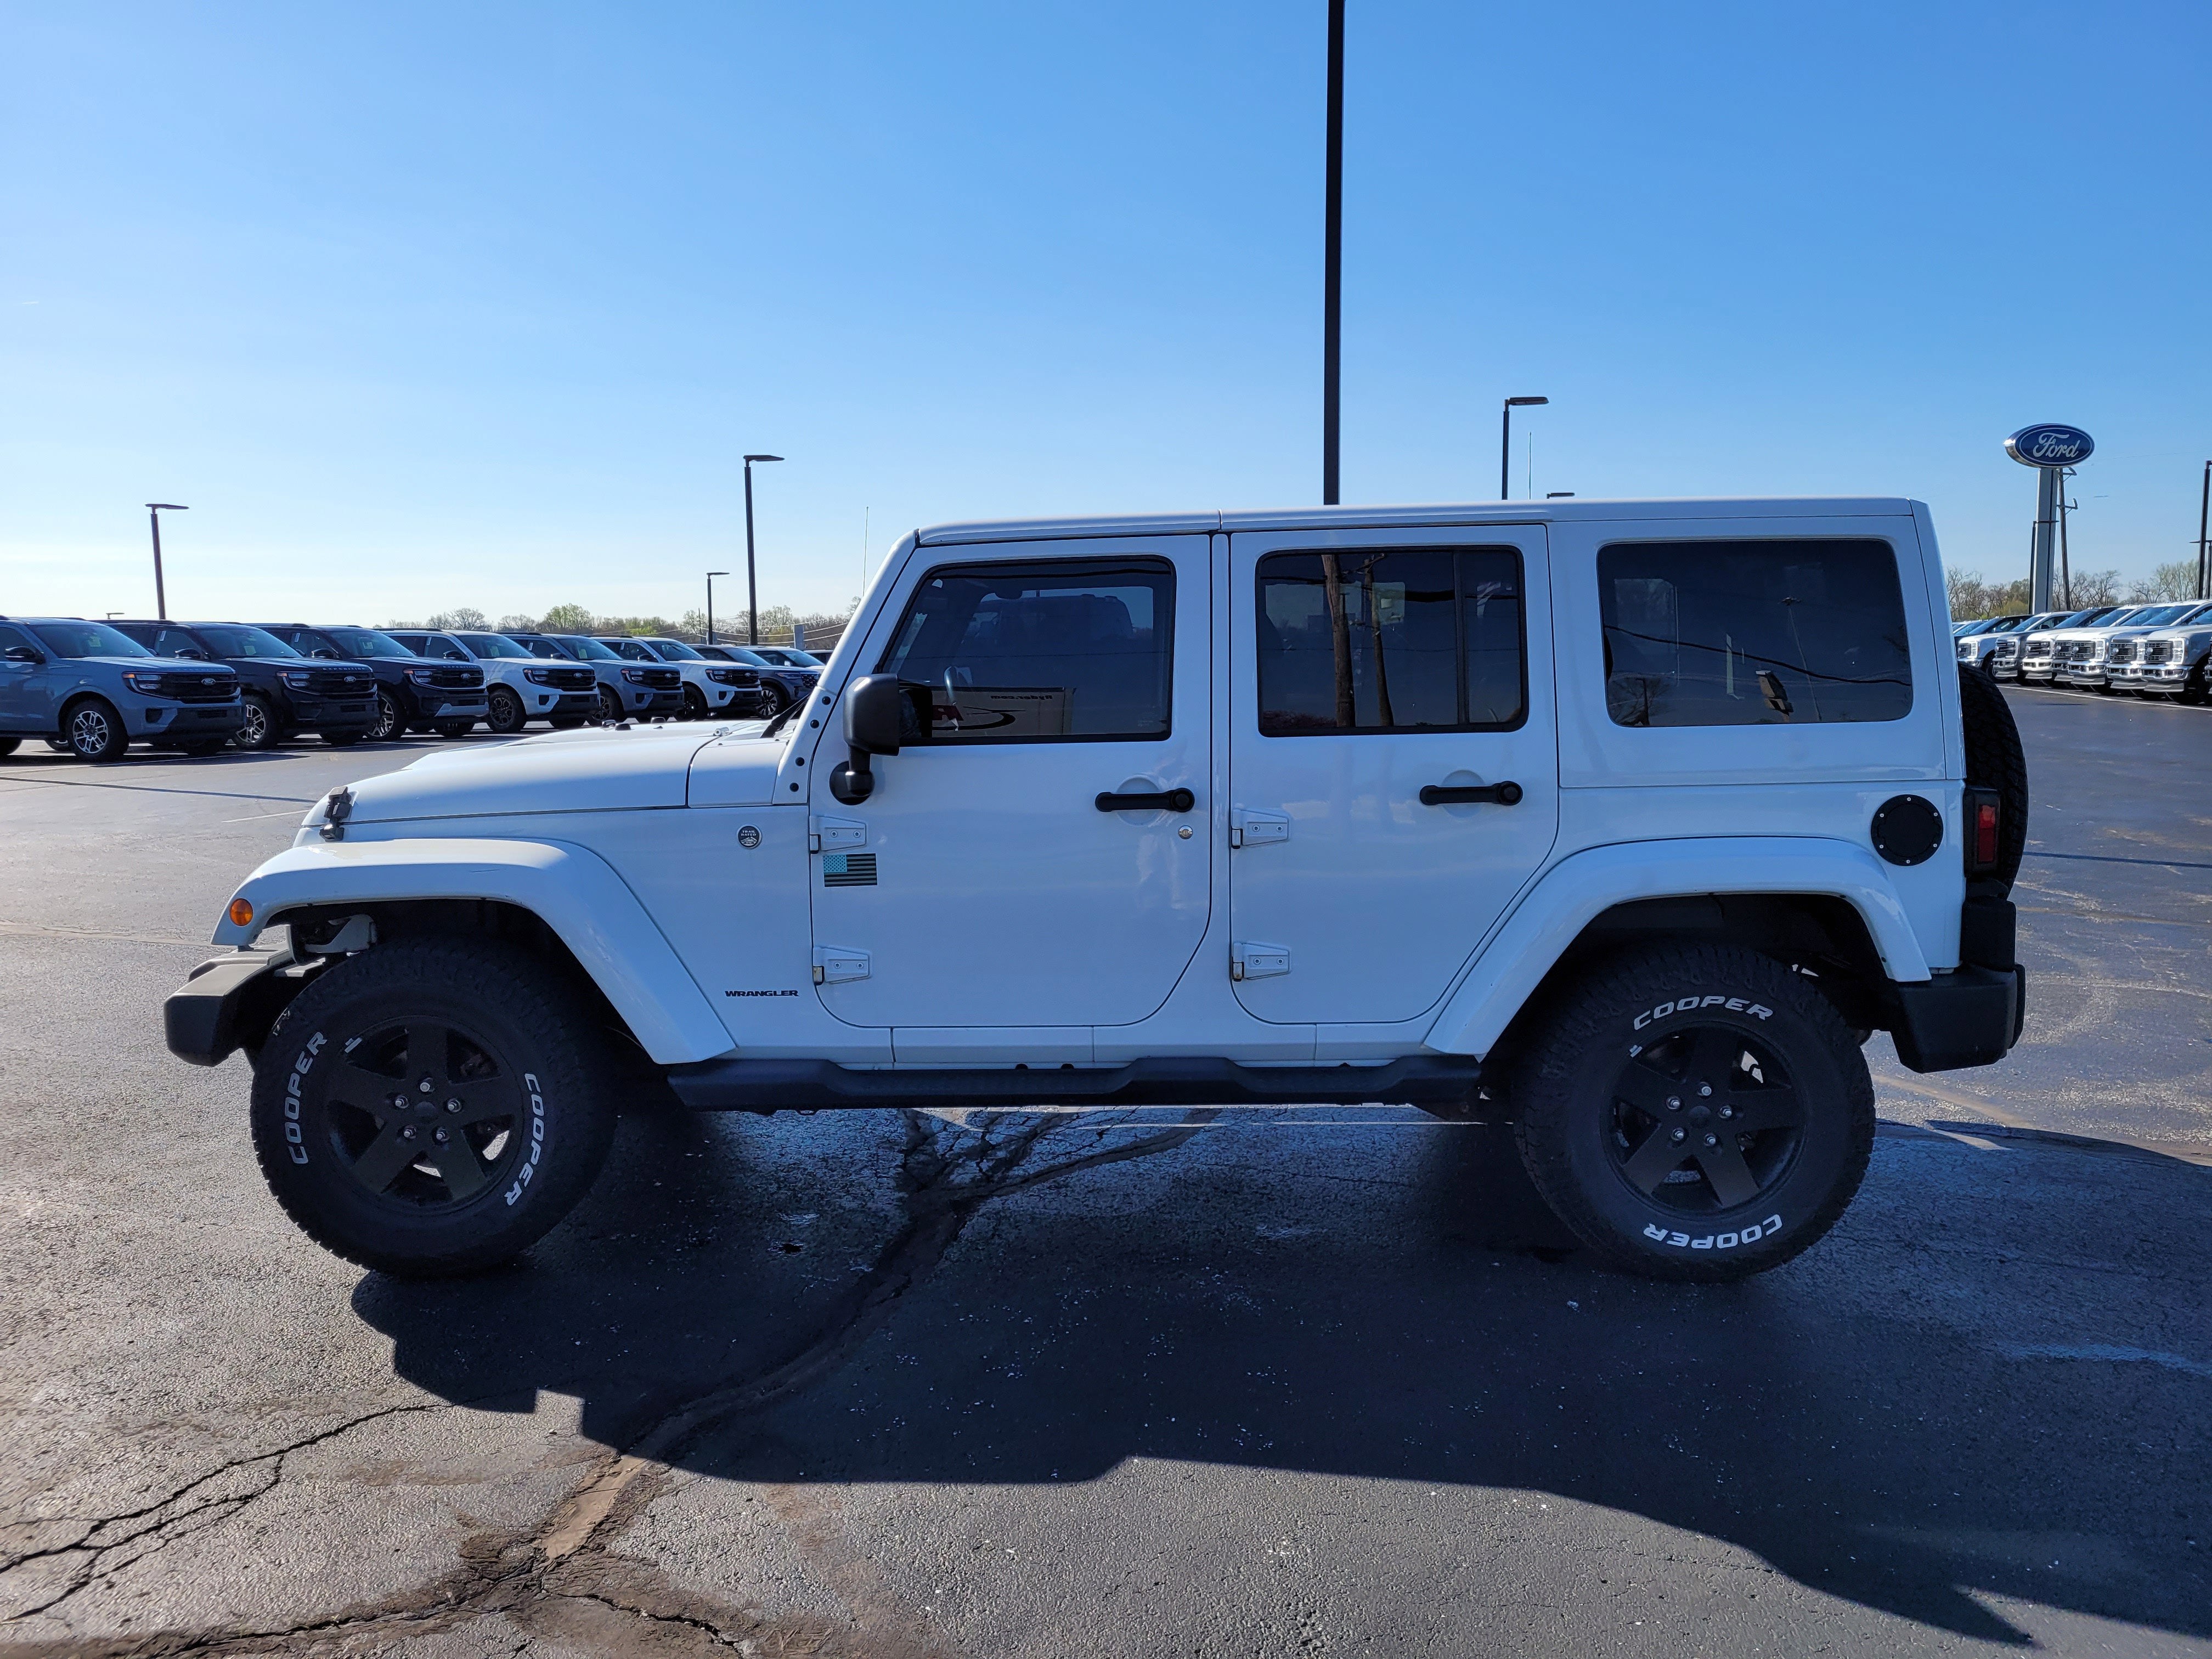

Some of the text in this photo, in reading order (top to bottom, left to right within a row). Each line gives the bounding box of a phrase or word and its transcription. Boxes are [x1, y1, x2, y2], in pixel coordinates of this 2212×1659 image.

[2033, 432, 2081, 458] Ford
[1633, 995, 1773, 1030] COOPER
[284, 1031, 328, 1164] COOPER
[504, 1073, 545, 1206] COOPER
[1643, 1214, 1783, 1249] COOPER
